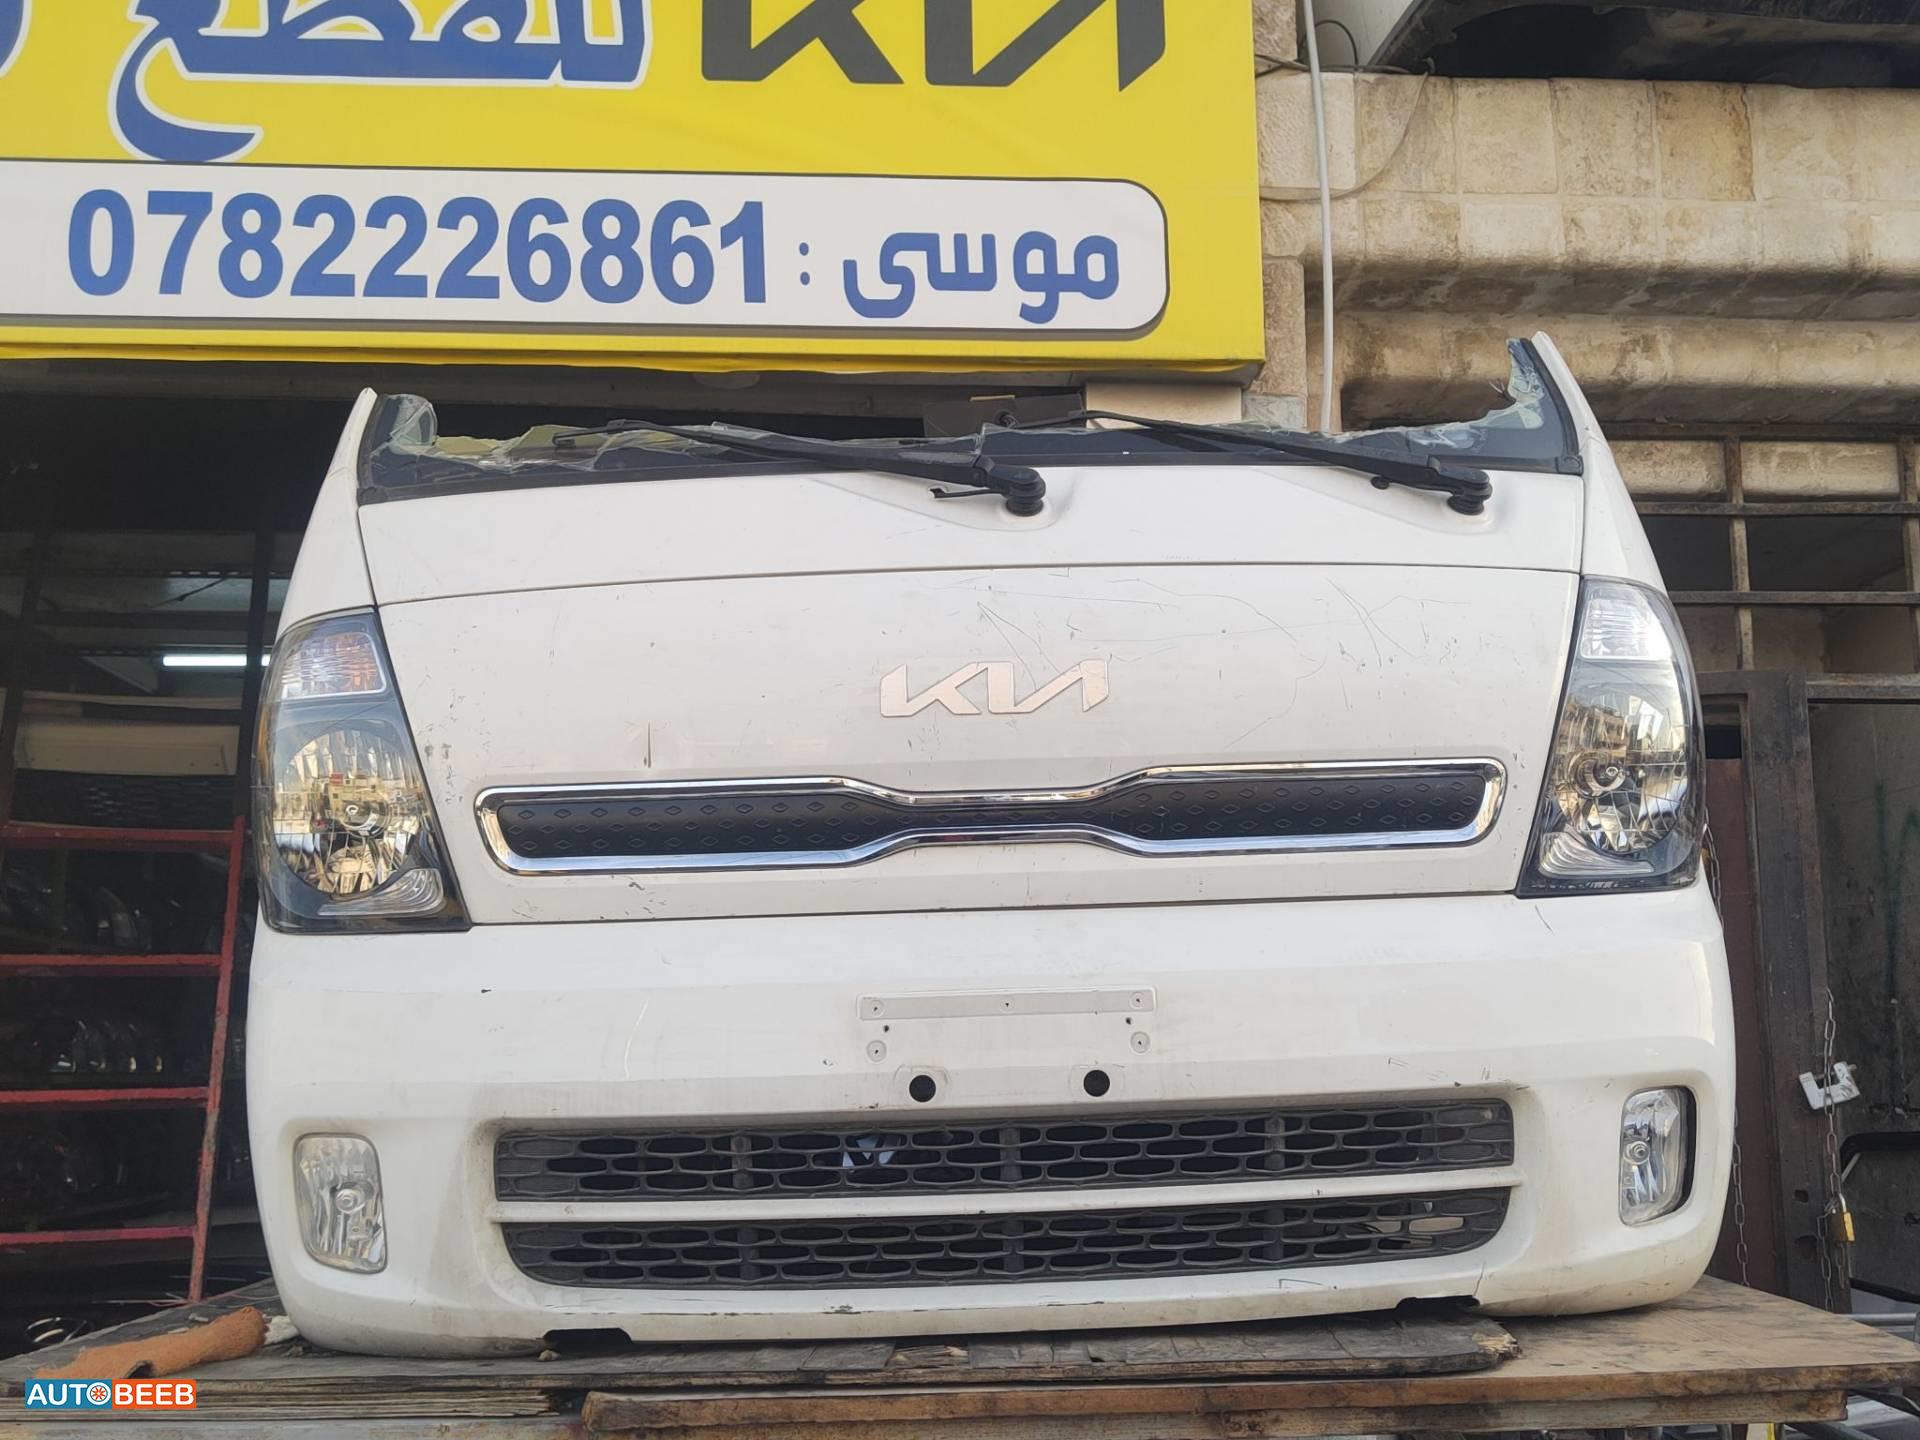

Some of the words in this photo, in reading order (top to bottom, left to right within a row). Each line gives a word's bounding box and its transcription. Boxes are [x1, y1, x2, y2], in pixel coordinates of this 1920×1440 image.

[67, 188, 766, 305] 0782226861
[843, 231, 1120, 325] موسى
[880, 658, 1109, 717] KIA
